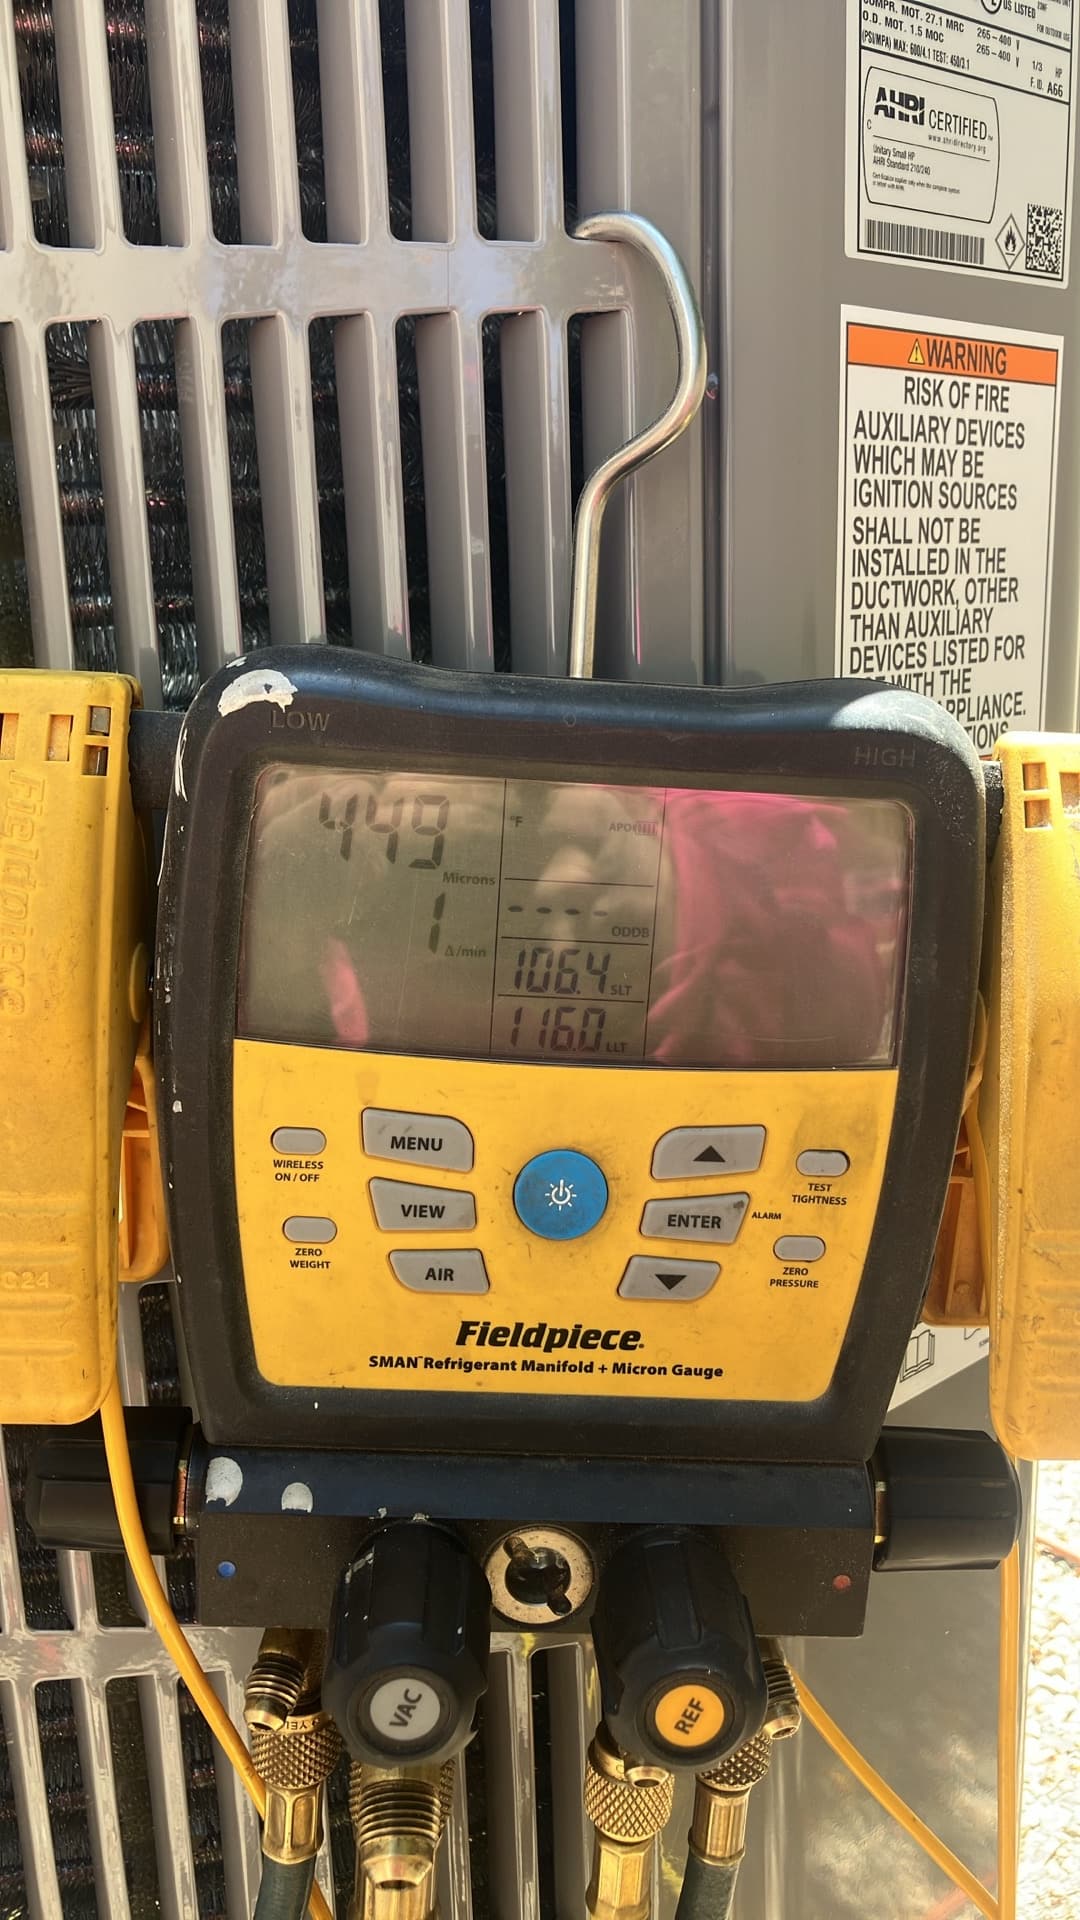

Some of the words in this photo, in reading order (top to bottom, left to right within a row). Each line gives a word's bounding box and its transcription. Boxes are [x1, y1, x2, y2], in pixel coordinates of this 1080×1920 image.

[925, 12, 942, 26] 27.1
[946, 18, 964, 32] MRC
[1014, 2, 1036, 19] LISTED
[910, 24, 922, 37] 1.5
[926, 29, 944, 43] MOC
[1032, 60, 1043, 72] 1/3
[1047, 81, 1063, 97] A66
[874, 86, 925, 125] AHRI
[929, 109, 988, 140] CERTIFIED
[926, 338, 1007, 375] WARNING
[904, 375, 944, 408] RISK
[949, 380, 971, 410] OF
[975, 383, 1010, 413] FIRE
[853, 409, 951, 445] AUXILIARY
[955, 417, 1025, 450] DEVICES
[853, 444, 916, 476] WHICH
[921, 448, 958, 477] MAY
[962, 450, 984, 479] BE
[853, 478, 933, 509] IGNITION
[938, 481, 1017, 511] SOURCES
[852, 516, 913, 546] SHALL
[918, 517, 954, 545] NOT
[959, 518, 981, 545] BE
[852, 548, 949, 578] INSTALLED
[954, 547, 970, 574] IN
[975, 547, 1007, 574] THE
[851, 578, 960, 611] DUCTWORK,
[964, 577, 1019, 605] OTHER
[850, 611, 900, 643] THAN
[904, 607, 994, 639] AUXILIARY
[850, 640, 927, 674] DEVICES
[932, 636, 989, 667] LISTED
[994, 634, 1026, 662] FOR
[939, 668, 972, 696] THE
[271, 709, 330, 732] LOW
[854, 746, 916, 767] HIGH
[318, 791, 450, 870] 449
[442, 872, 496, 886] Microns
[428, 892, 446, 954] 1
[611, 925, 650, 938] ODDB
[514, 947, 611, 995] 106.4
[610, 985, 633, 997] SLT
[605, 1041, 628, 1053] LLT
[390, 1136, 443, 1152] MENU
[273, 1159, 324, 1170] WIRELESS
[274, 1172, 290, 1182] ON
[300, 1173, 320, 1183] OFF
[807, 1183, 832, 1193] TEST
[400, 1204, 446, 1219] VIEW
[791, 1194, 847, 1206] TIGHTNESS
[667, 1214, 721, 1230] ENTER
[751, 1211, 782, 1221] ALARM
[289, 1259, 331, 1269] WEIGHT
[295, 1248, 323, 1257] ZERO
[424, 1268, 454, 1282] AIR
[782, 1267, 809, 1276] ZERO
[769, 1278, 819, 1289] PRESSURE
[455, 1320, 645, 1353] Fieldpiece
[423, 1356, 517, 1375] Refrigerant
[520, 1359, 595, 1374] Manifold
[597, 1364, 608, 1375] +
[612, 1362, 667, 1376] Micron
[671, 1364, 724, 1380] Gauge
[388, 1688, 424, 1730] VAC
[674, 1697, 706, 1736] REF
